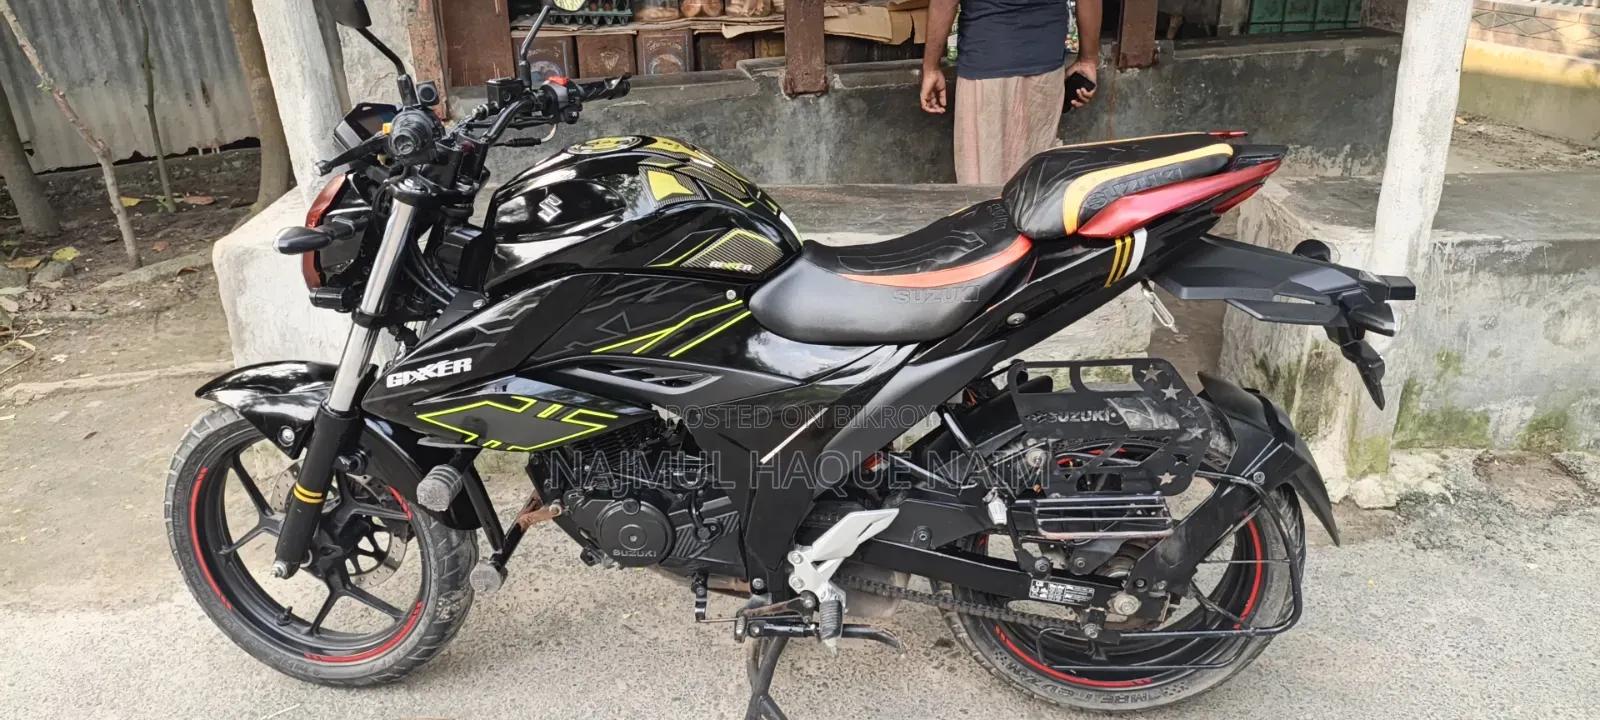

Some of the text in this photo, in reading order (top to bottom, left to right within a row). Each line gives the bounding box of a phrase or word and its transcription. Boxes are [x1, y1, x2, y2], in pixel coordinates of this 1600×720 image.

[1086, 168, 1184, 210] SUZUKI
[893, 284, 981, 305] SUZUKI
[386, 357, 473, 388] GIXXER
[1047, 409, 1110, 423] SUZUKI
[612, 549, 657, 557] SUZUKI
